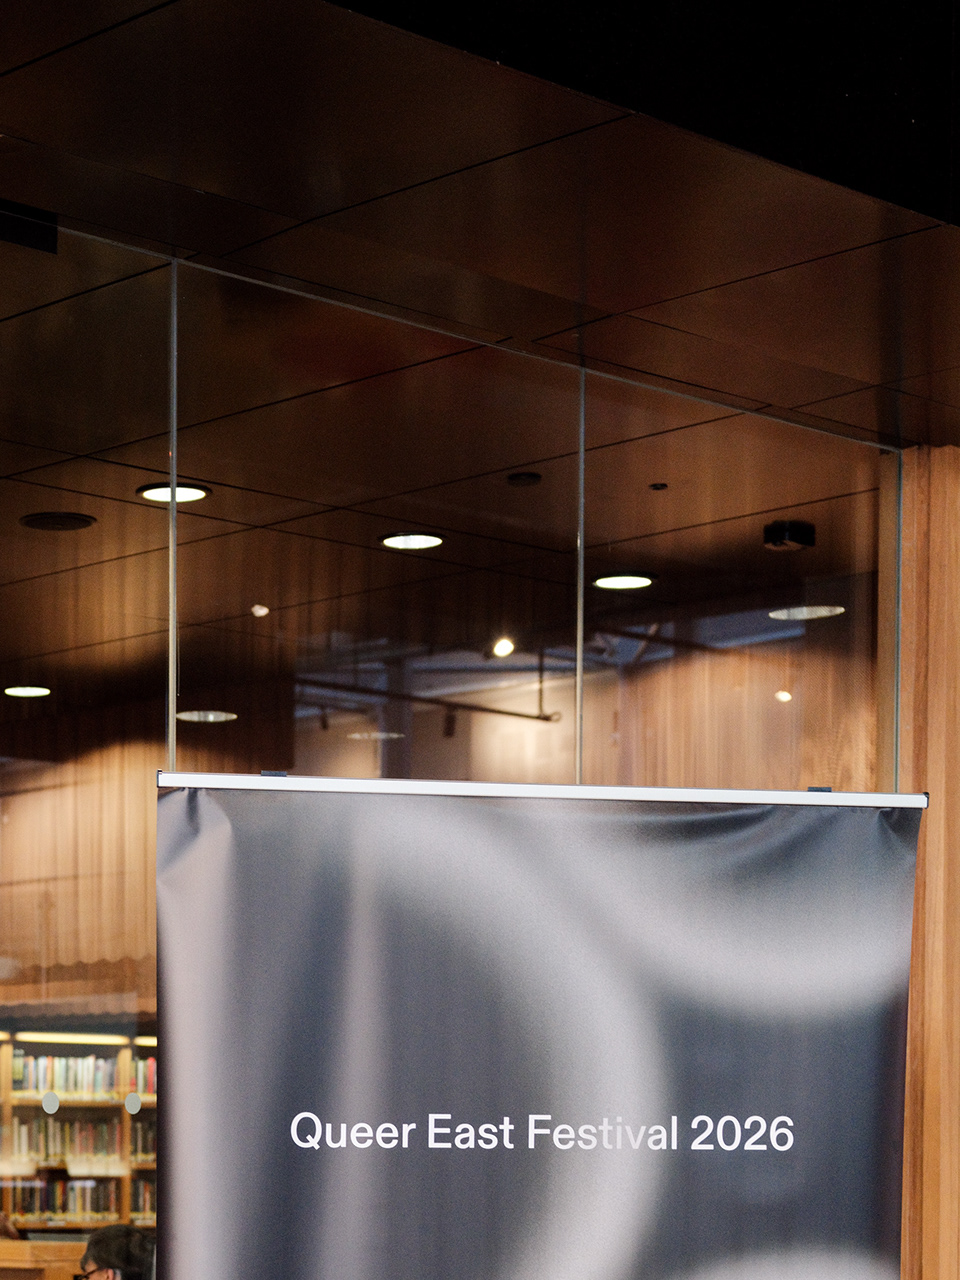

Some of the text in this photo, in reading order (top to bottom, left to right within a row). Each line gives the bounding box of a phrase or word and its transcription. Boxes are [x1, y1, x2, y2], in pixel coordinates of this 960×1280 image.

[289, 1111, 795, 1151] Queer East Festival 2026
